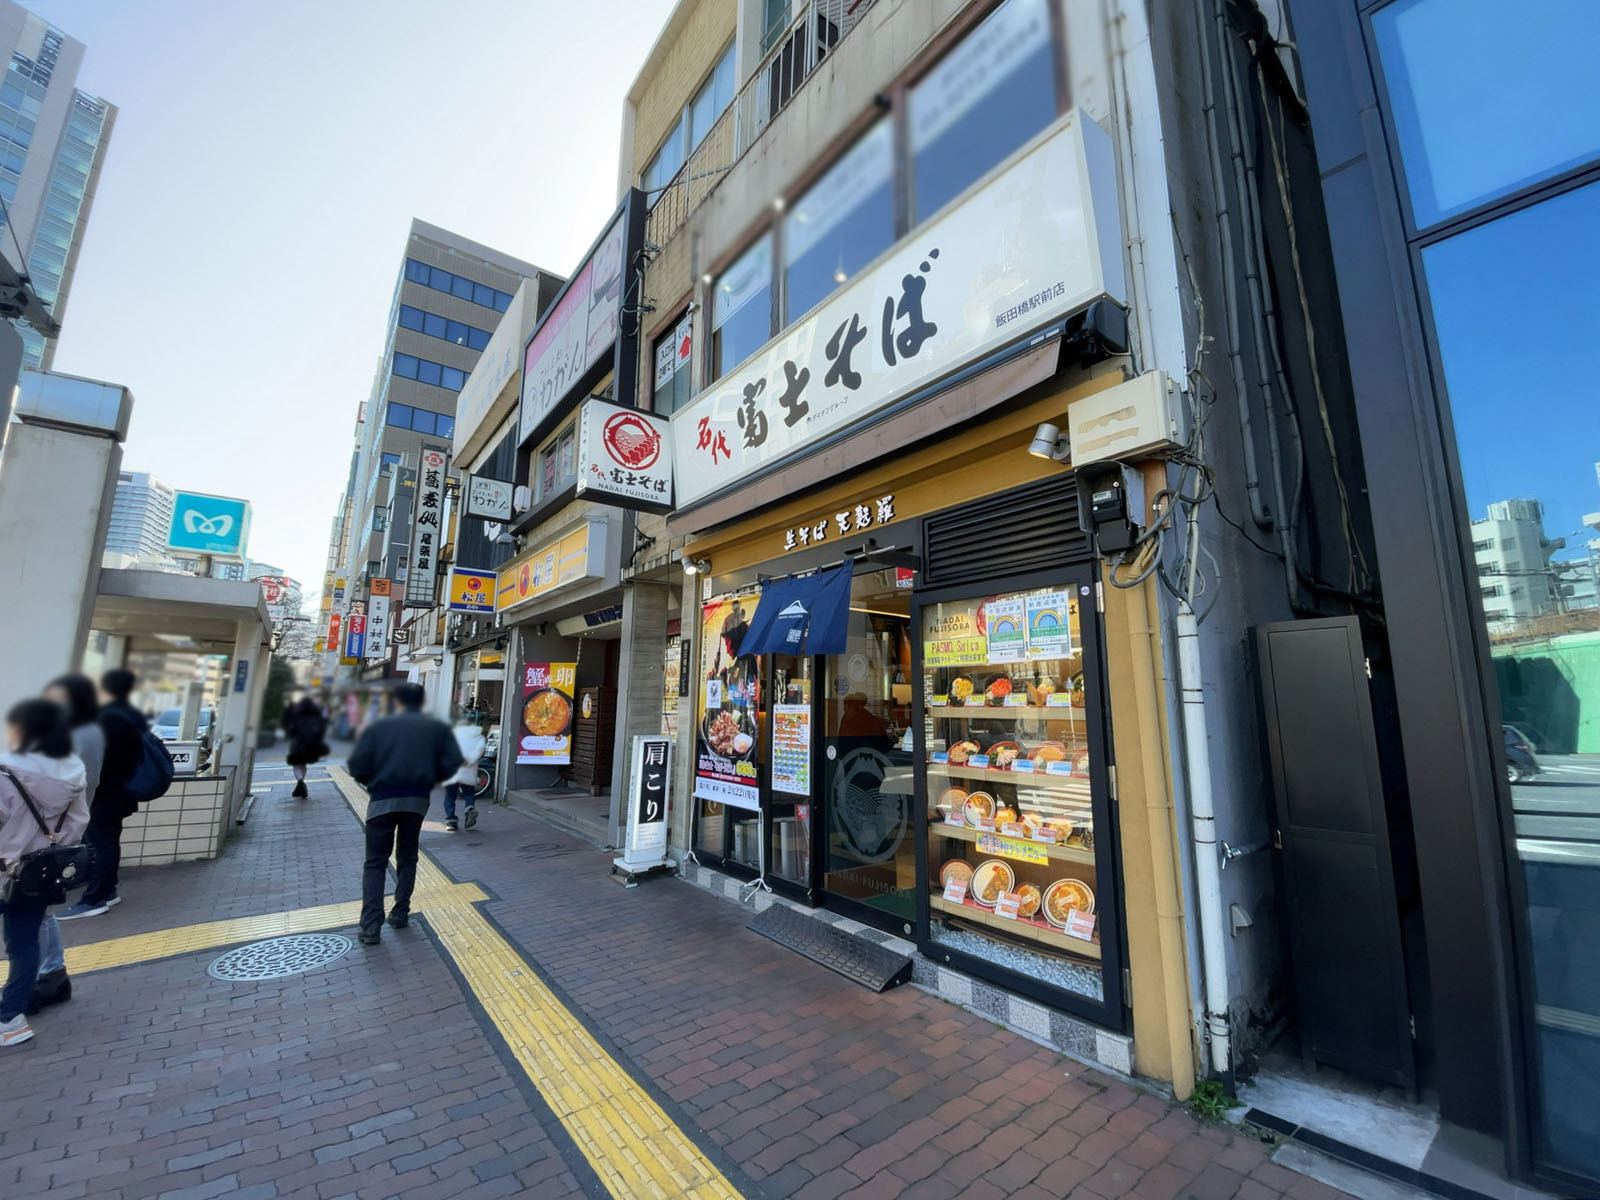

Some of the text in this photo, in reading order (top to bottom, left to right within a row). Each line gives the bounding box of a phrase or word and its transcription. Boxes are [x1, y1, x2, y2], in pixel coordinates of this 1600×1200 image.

[995, 281, 1065, 328] 飯田橋駅前店
[696, 416, 731, 465] 名代
[737, 248, 940, 450] 富士そば
[598, 483, 659, 500] NADAI FUJISOBA
[784, 520, 828, 550] 生そば
[417, 533, 433, 570] 尾張屋
[460, 591, 487, 604] 松屋
[929, 622, 970, 634] FUJISOBA
[936, 615, 964, 625] NADAI
[956, 640, 980, 653] Suica
[645, 743, 667, 822] 肩こり
